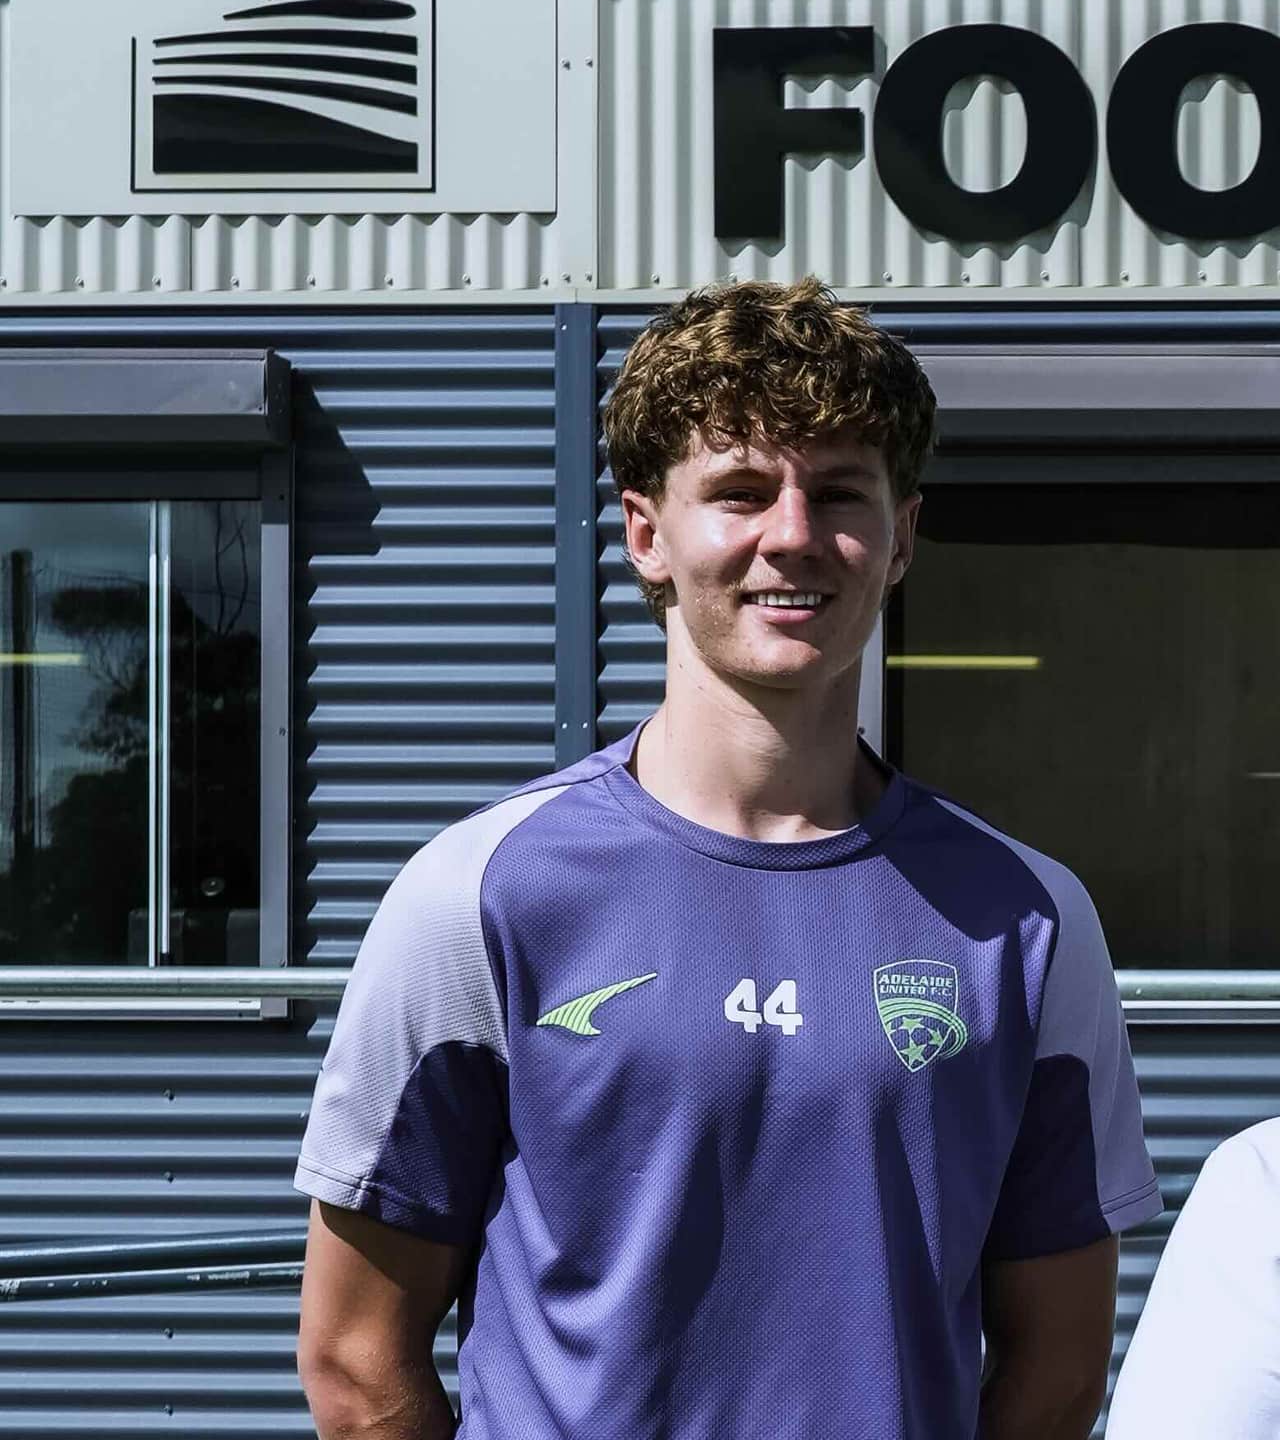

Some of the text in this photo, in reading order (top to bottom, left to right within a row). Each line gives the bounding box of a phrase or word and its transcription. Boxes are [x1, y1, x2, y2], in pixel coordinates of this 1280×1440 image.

[878, 974, 954, 988] ADELAIDE
[879, 984, 926, 995] UNITED
[724, 978, 803, 1036] 44
